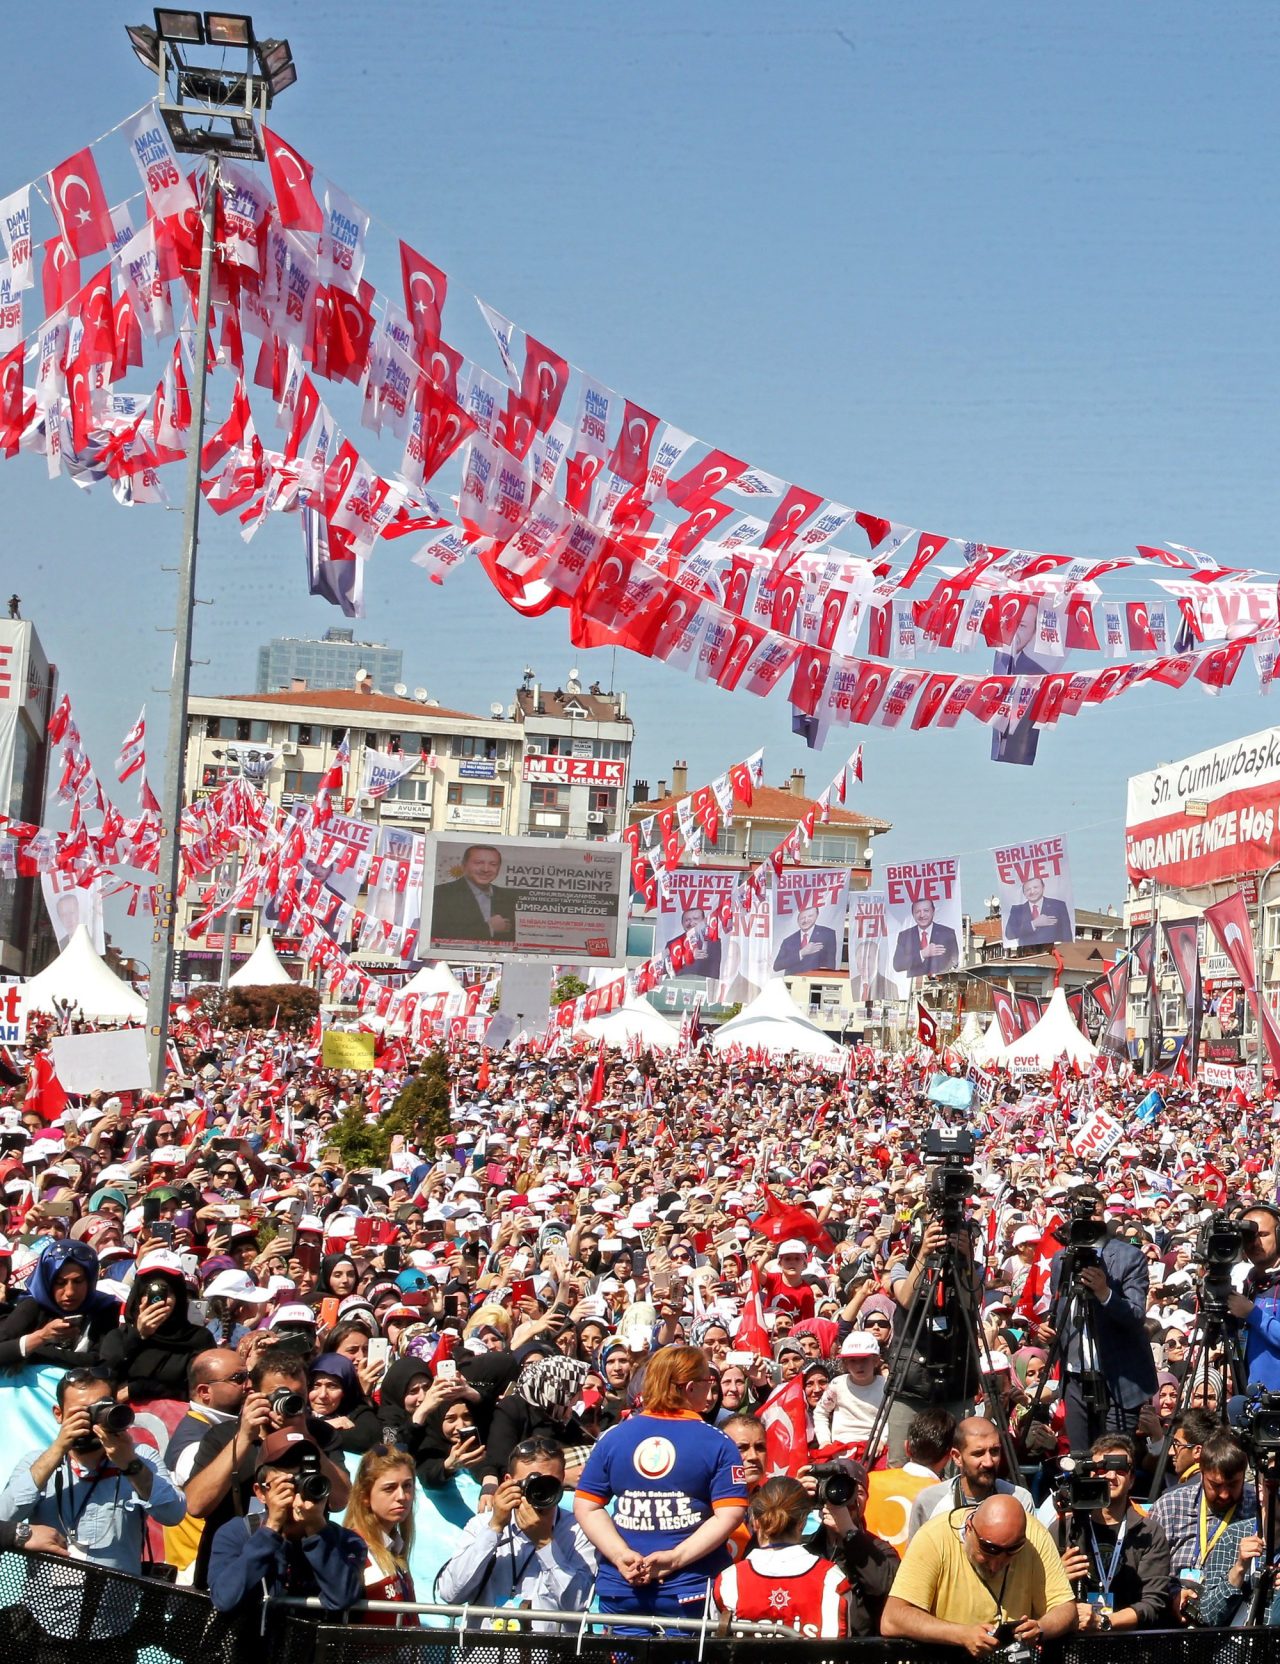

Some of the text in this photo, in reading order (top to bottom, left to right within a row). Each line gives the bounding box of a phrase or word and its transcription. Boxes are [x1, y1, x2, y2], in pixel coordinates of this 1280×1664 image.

[530, 758, 621, 778] MÜZİK
[571, 776, 620, 786] MERKEZİ
[1151, 774, 1171, 805] Sn.
[398, 805, 425, 813] AVUKAT
[1127, 810, 1237, 871] ÜMRANİYE'MİZE
[1240, 804, 1274, 845] Hoş
[995, 838, 1063, 864] BİRLİKTE
[506, 865, 613, 880] HAYDİ ÜMRANİYE
[887, 860, 956, 880] BİRLİKTE
[998, 853, 1063, 884] EVET
[505, 875, 612, 892] HAZIR MISIN?
[777, 871, 845, 890] BİRLİKTE
[887, 876, 956, 904] EVET
[515, 901, 608, 916] ÜMRANİYEMİZDE
[661, 889, 732, 913] EVET
[777, 884, 844, 915] EVET
[1208, 957, 1228, 969] AVUKAT
[1014, 1055, 1040, 1067] evet
[969, 1066, 992, 1091] evet
[1207, 1065, 1234, 1080] evet
[1076, 1115, 1112, 1156] evet
[625, 1490, 647, 1498] Sağlık
[618, 1497, 691, 1517] UMKE
[614, 1512, 701, 1531] MEDICAL RESCUE
